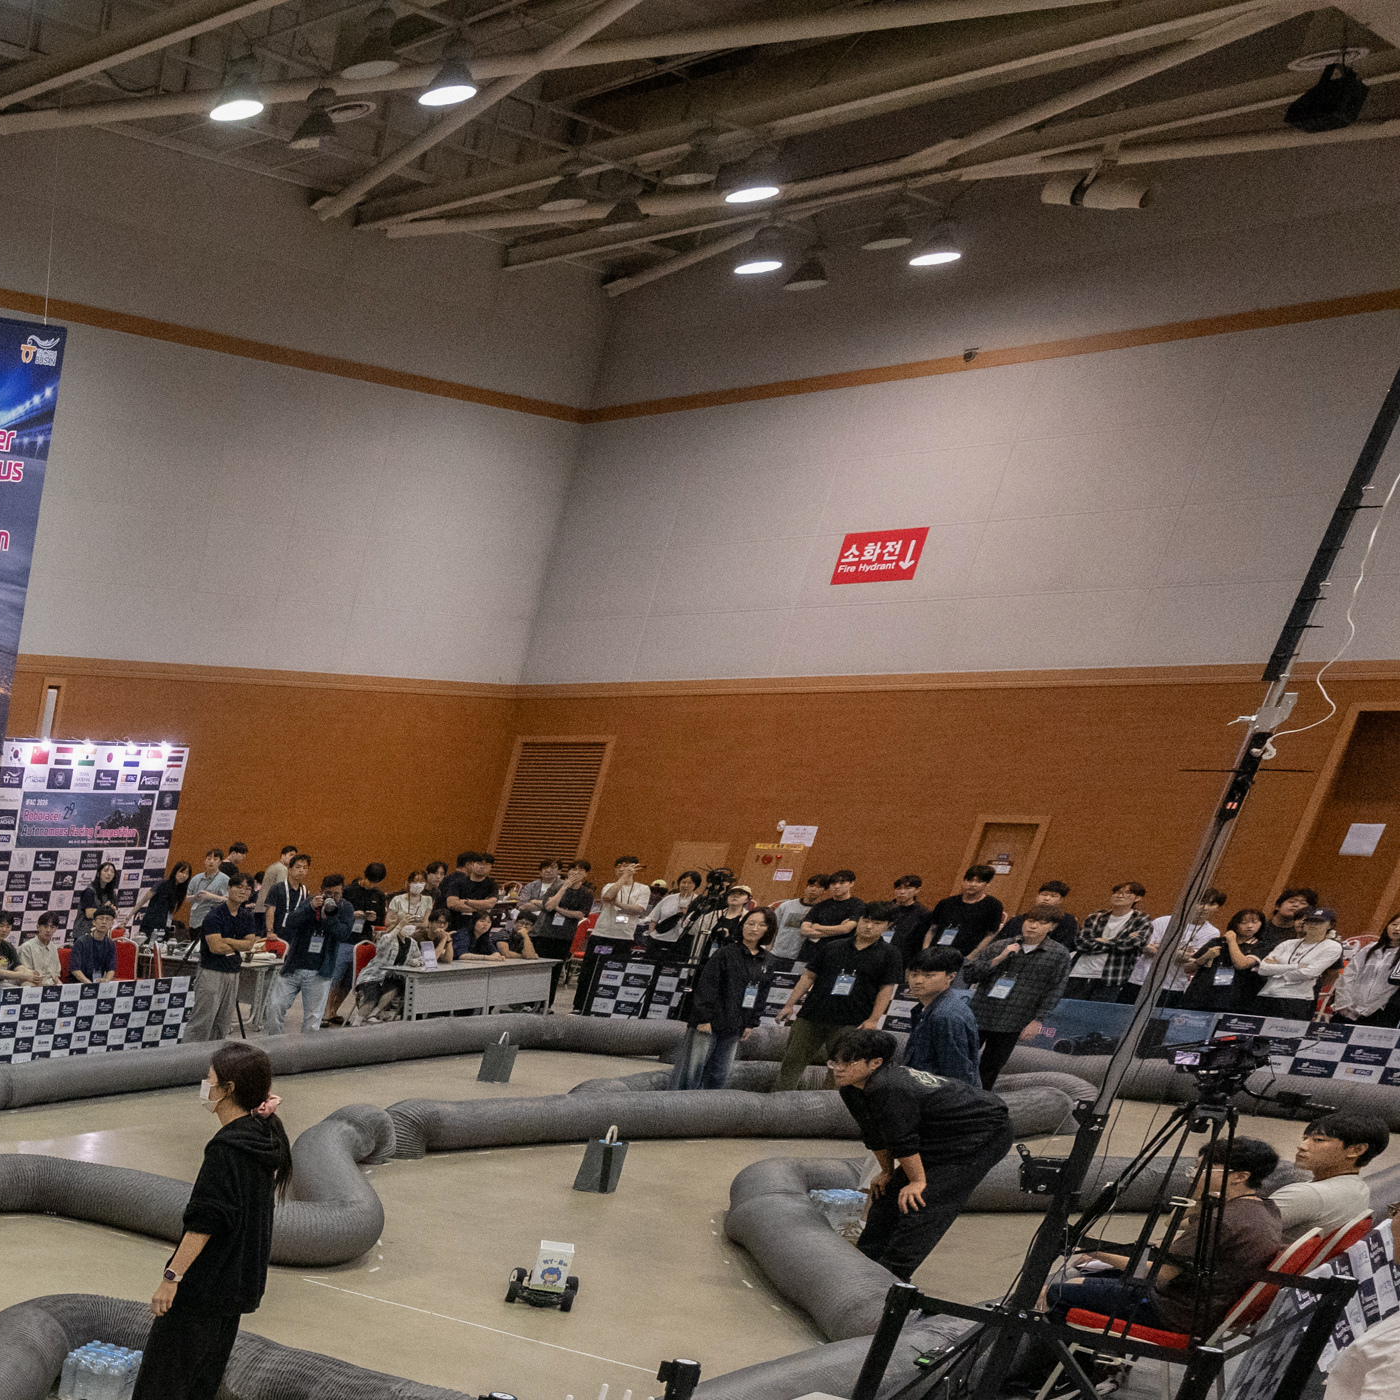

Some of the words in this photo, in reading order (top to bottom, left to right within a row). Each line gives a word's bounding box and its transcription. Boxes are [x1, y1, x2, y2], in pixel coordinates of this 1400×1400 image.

[840, 540, 903, 563] 소화전
[837, 564, 857, 574] Fire
[858, 561, 896, 573] Hydrant
[23, 809, 62, 822] Roboracer
[21, 824, 68, 837] Autonomous
[68, 827, 94, 839] Racing
[94, 826, 137, 841] Competition
